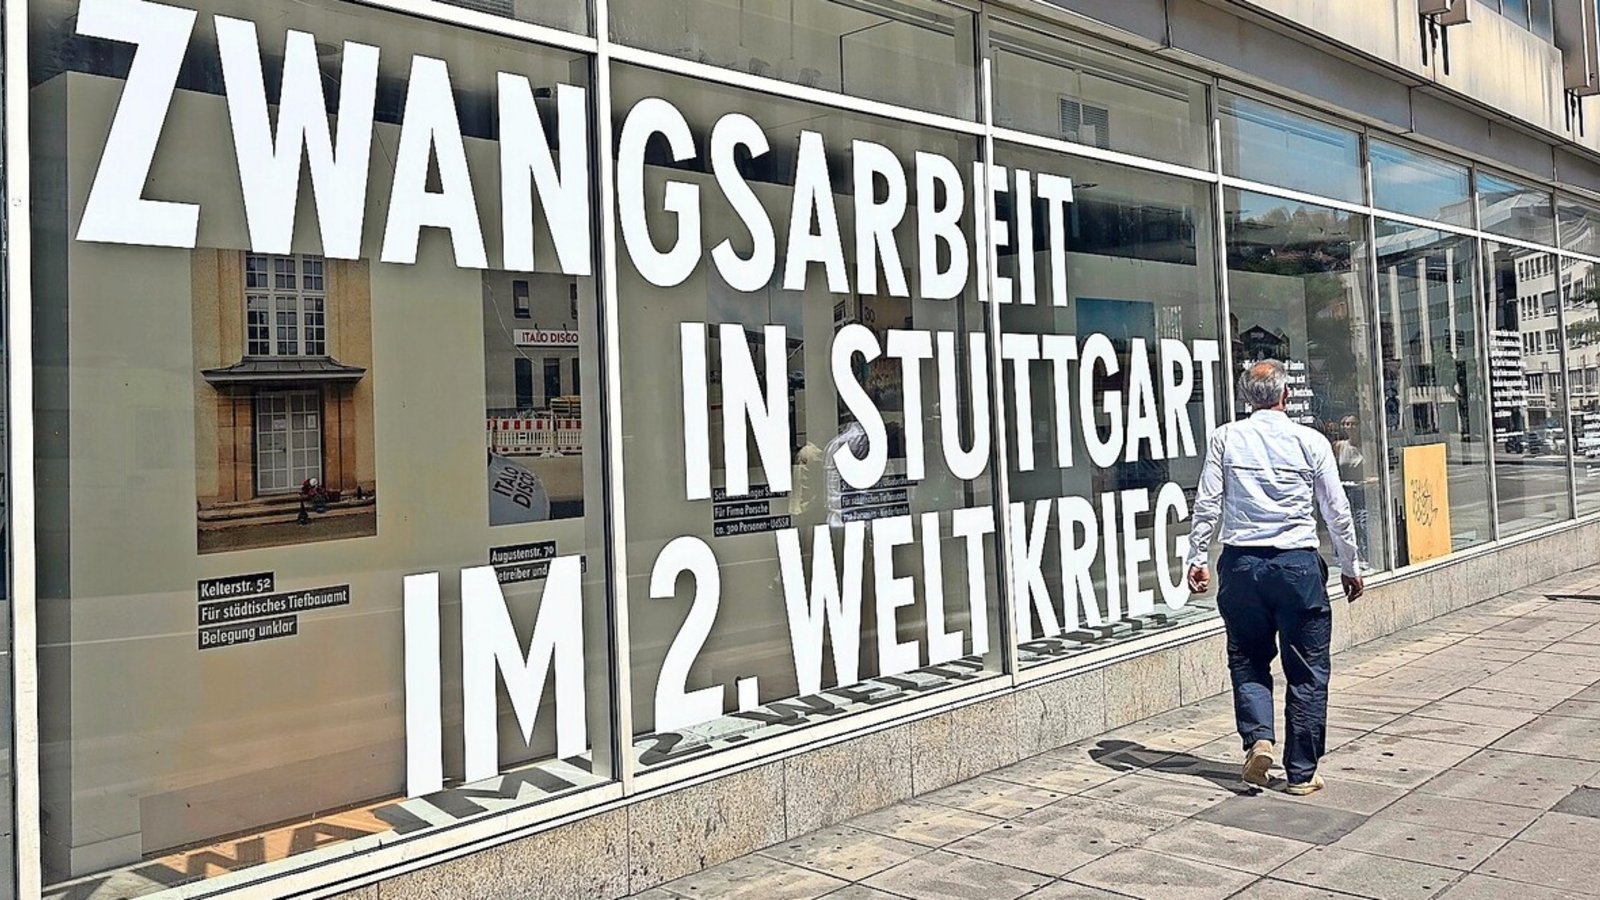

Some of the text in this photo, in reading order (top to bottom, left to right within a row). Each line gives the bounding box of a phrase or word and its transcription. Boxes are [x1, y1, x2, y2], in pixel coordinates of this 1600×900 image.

[75, 0, 1074, 307] ZWANGSARBEIT
[522, 332, 579, 344] ITALO DISCO
[680, 321, 1220, 501] IN STUTTGART
[492, 466, 519, 497] ITALO
[513, 471, 535, 509] DISCO
[715, 507, 725, 518] Für
[745, 503, 768, 515] Porsche
[739, 521, 767, 532] Personen
[491, 545, 555, 564] Augustenstr. 70
[497, 563, 548, 581] etreiber und
[200, 578, 271, 598] Kelterstr. 52
[201, 589, 348, 622] Für städtisches Tiefbauamt
[201, 620, 295, 646] Belegung unklar
[403, 481, 1191, 799] IM 2. WELTKRIEG
